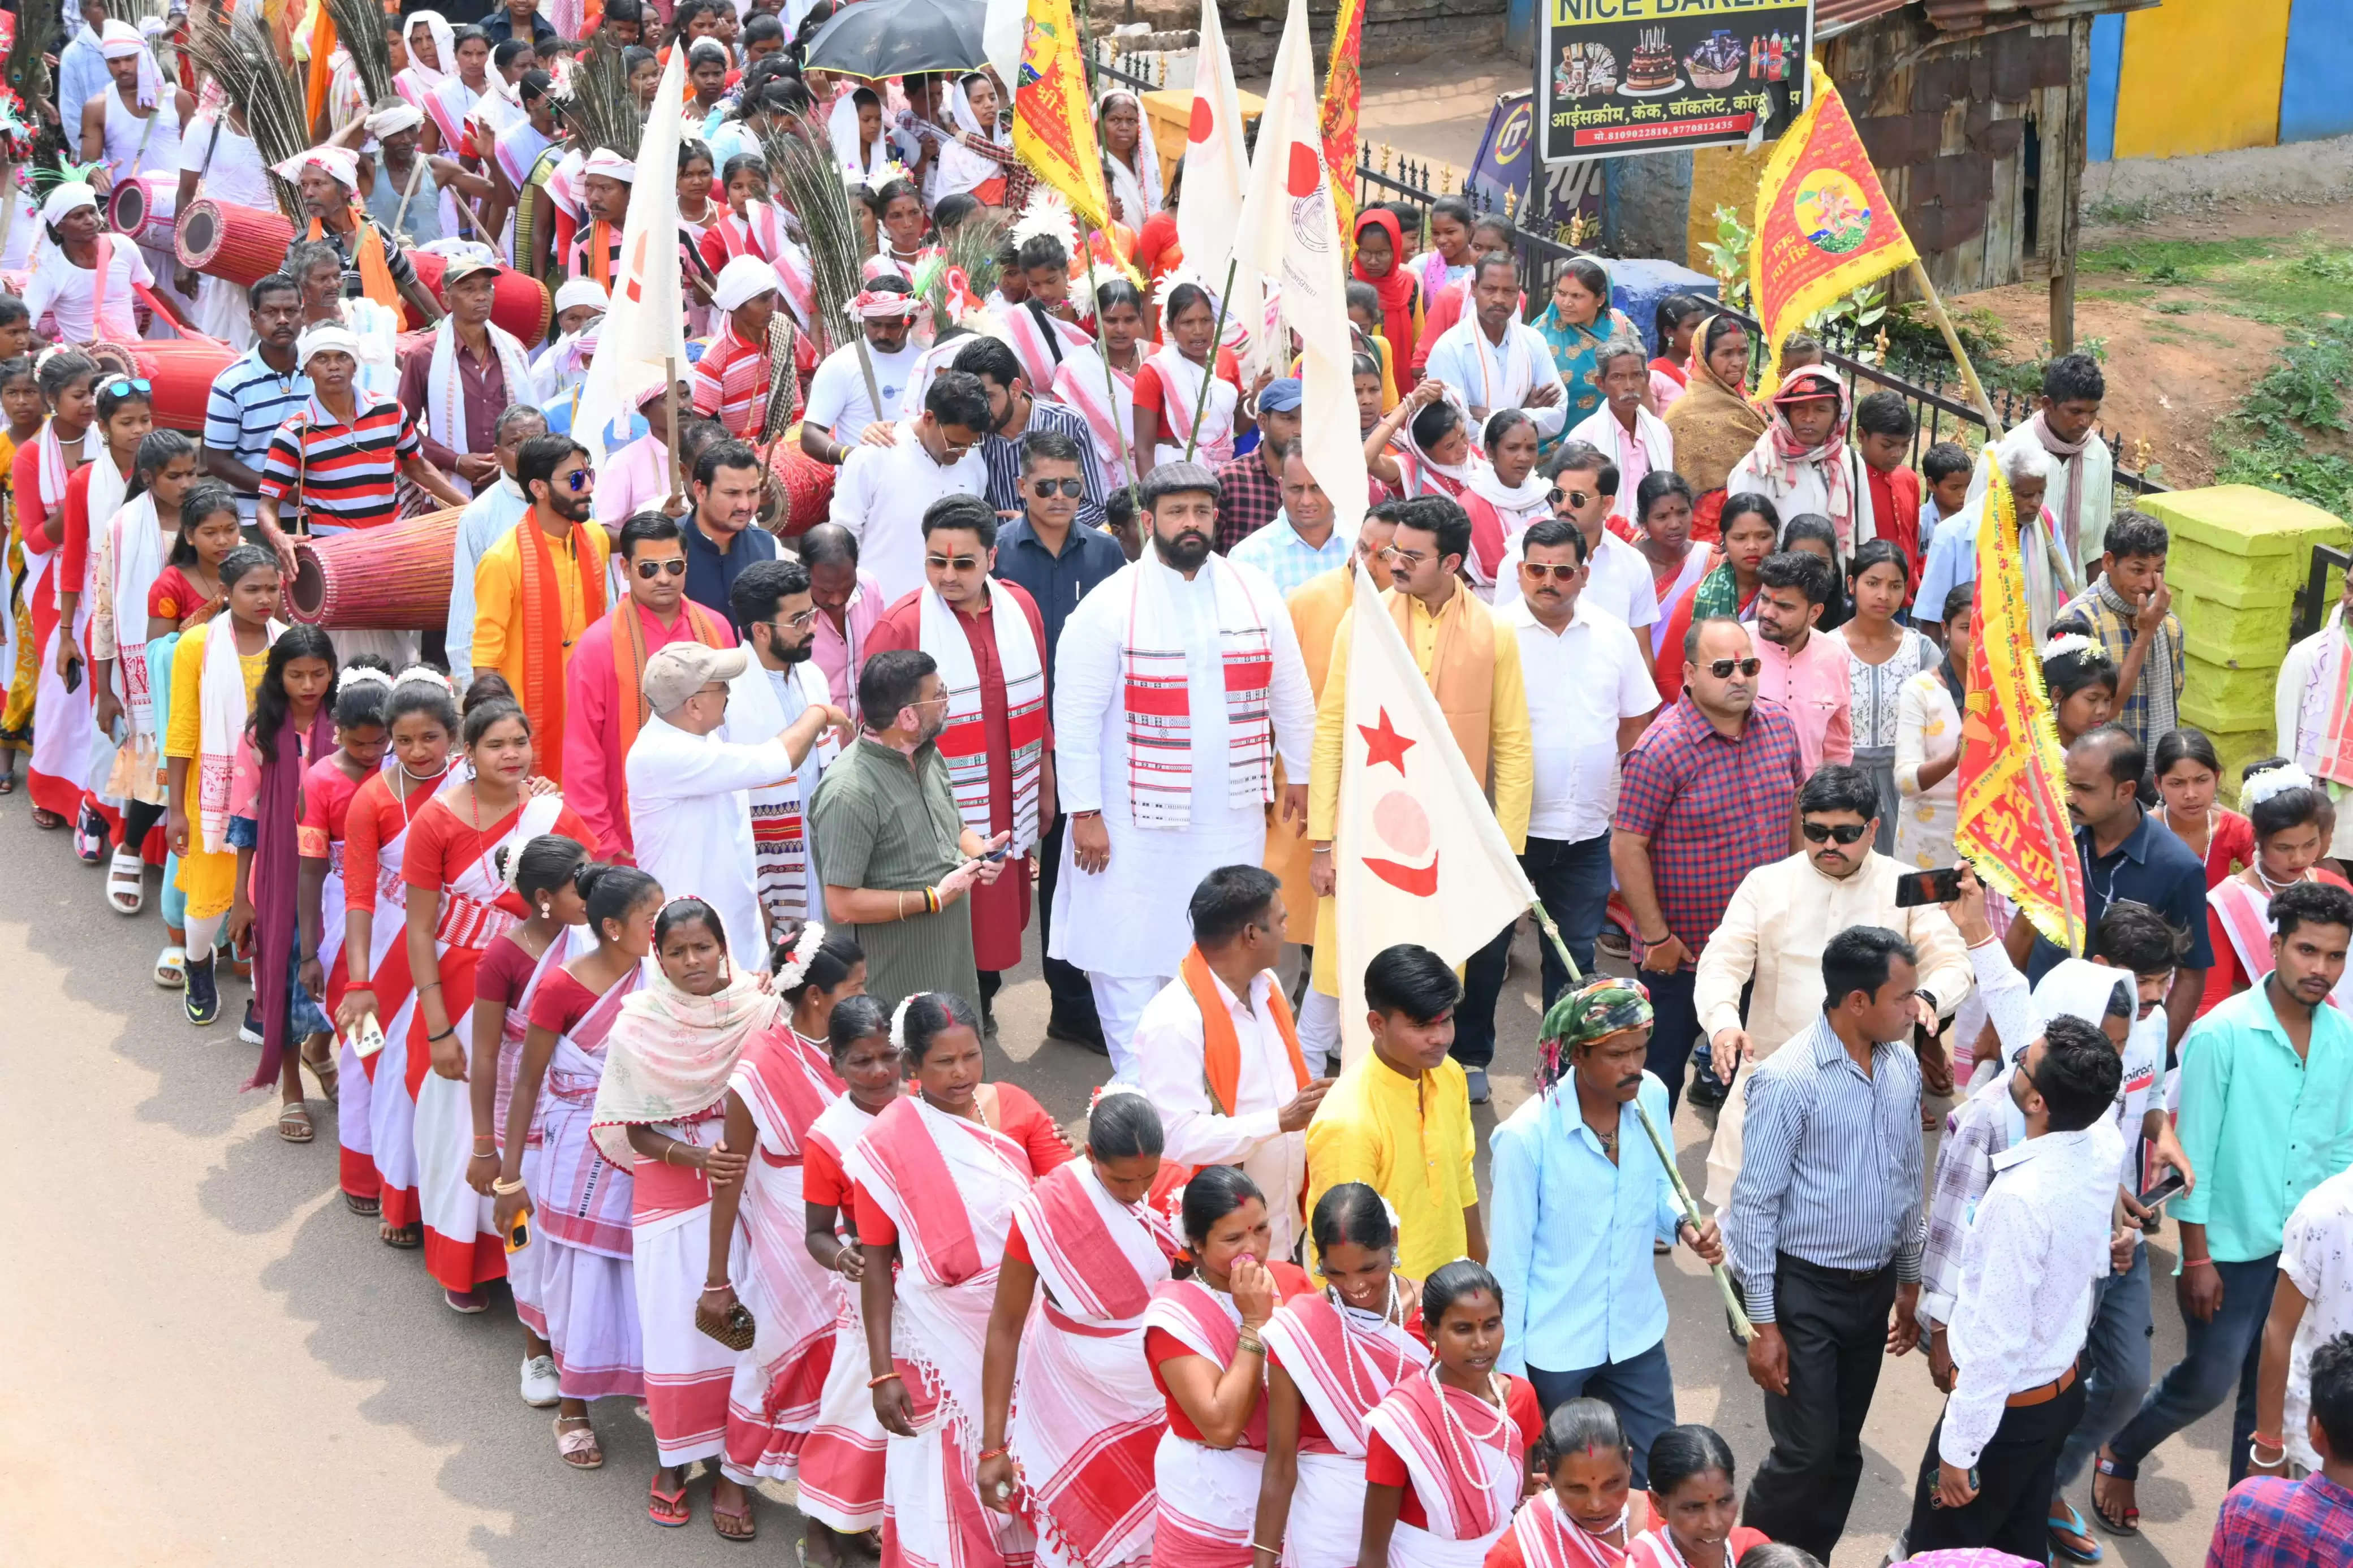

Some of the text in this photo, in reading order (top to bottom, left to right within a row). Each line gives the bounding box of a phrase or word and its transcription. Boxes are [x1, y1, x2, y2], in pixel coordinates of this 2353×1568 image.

[1559, 0, 1643, 21] NICE
[1981, 805, 2022, 854] श्री
[2020, 840, 2059, 894] राम
